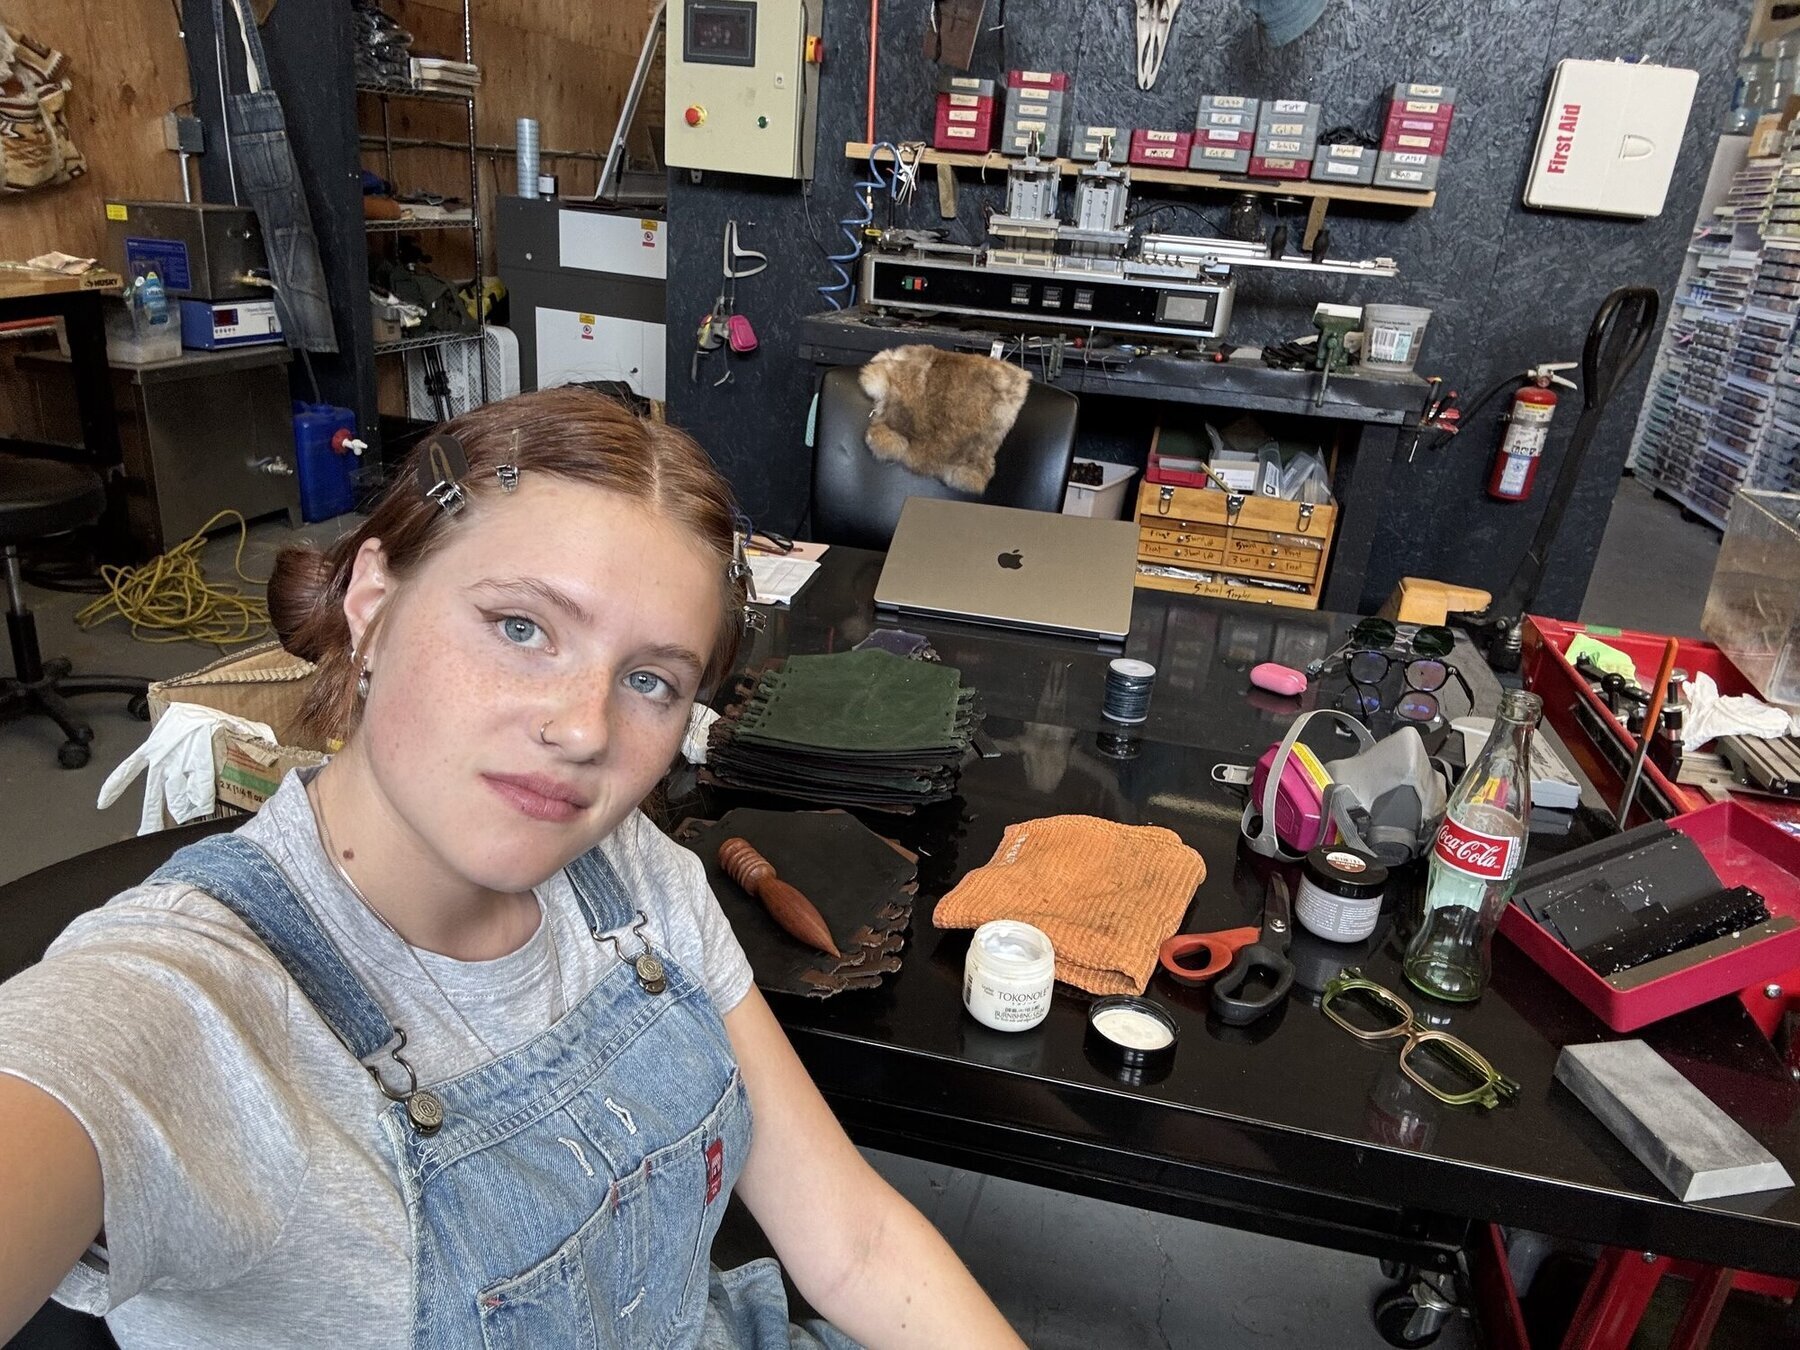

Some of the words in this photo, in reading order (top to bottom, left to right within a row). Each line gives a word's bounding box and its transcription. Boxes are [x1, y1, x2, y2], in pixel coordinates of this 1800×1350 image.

[1558, 104, 1581, 133] Aid
[1547, 135, 1573, 174] First
[94, 279, 118, 287] HUSKY
[220, 780, 225, 789] 2
[998, 987, 1047, 1002] TOKONOLE
